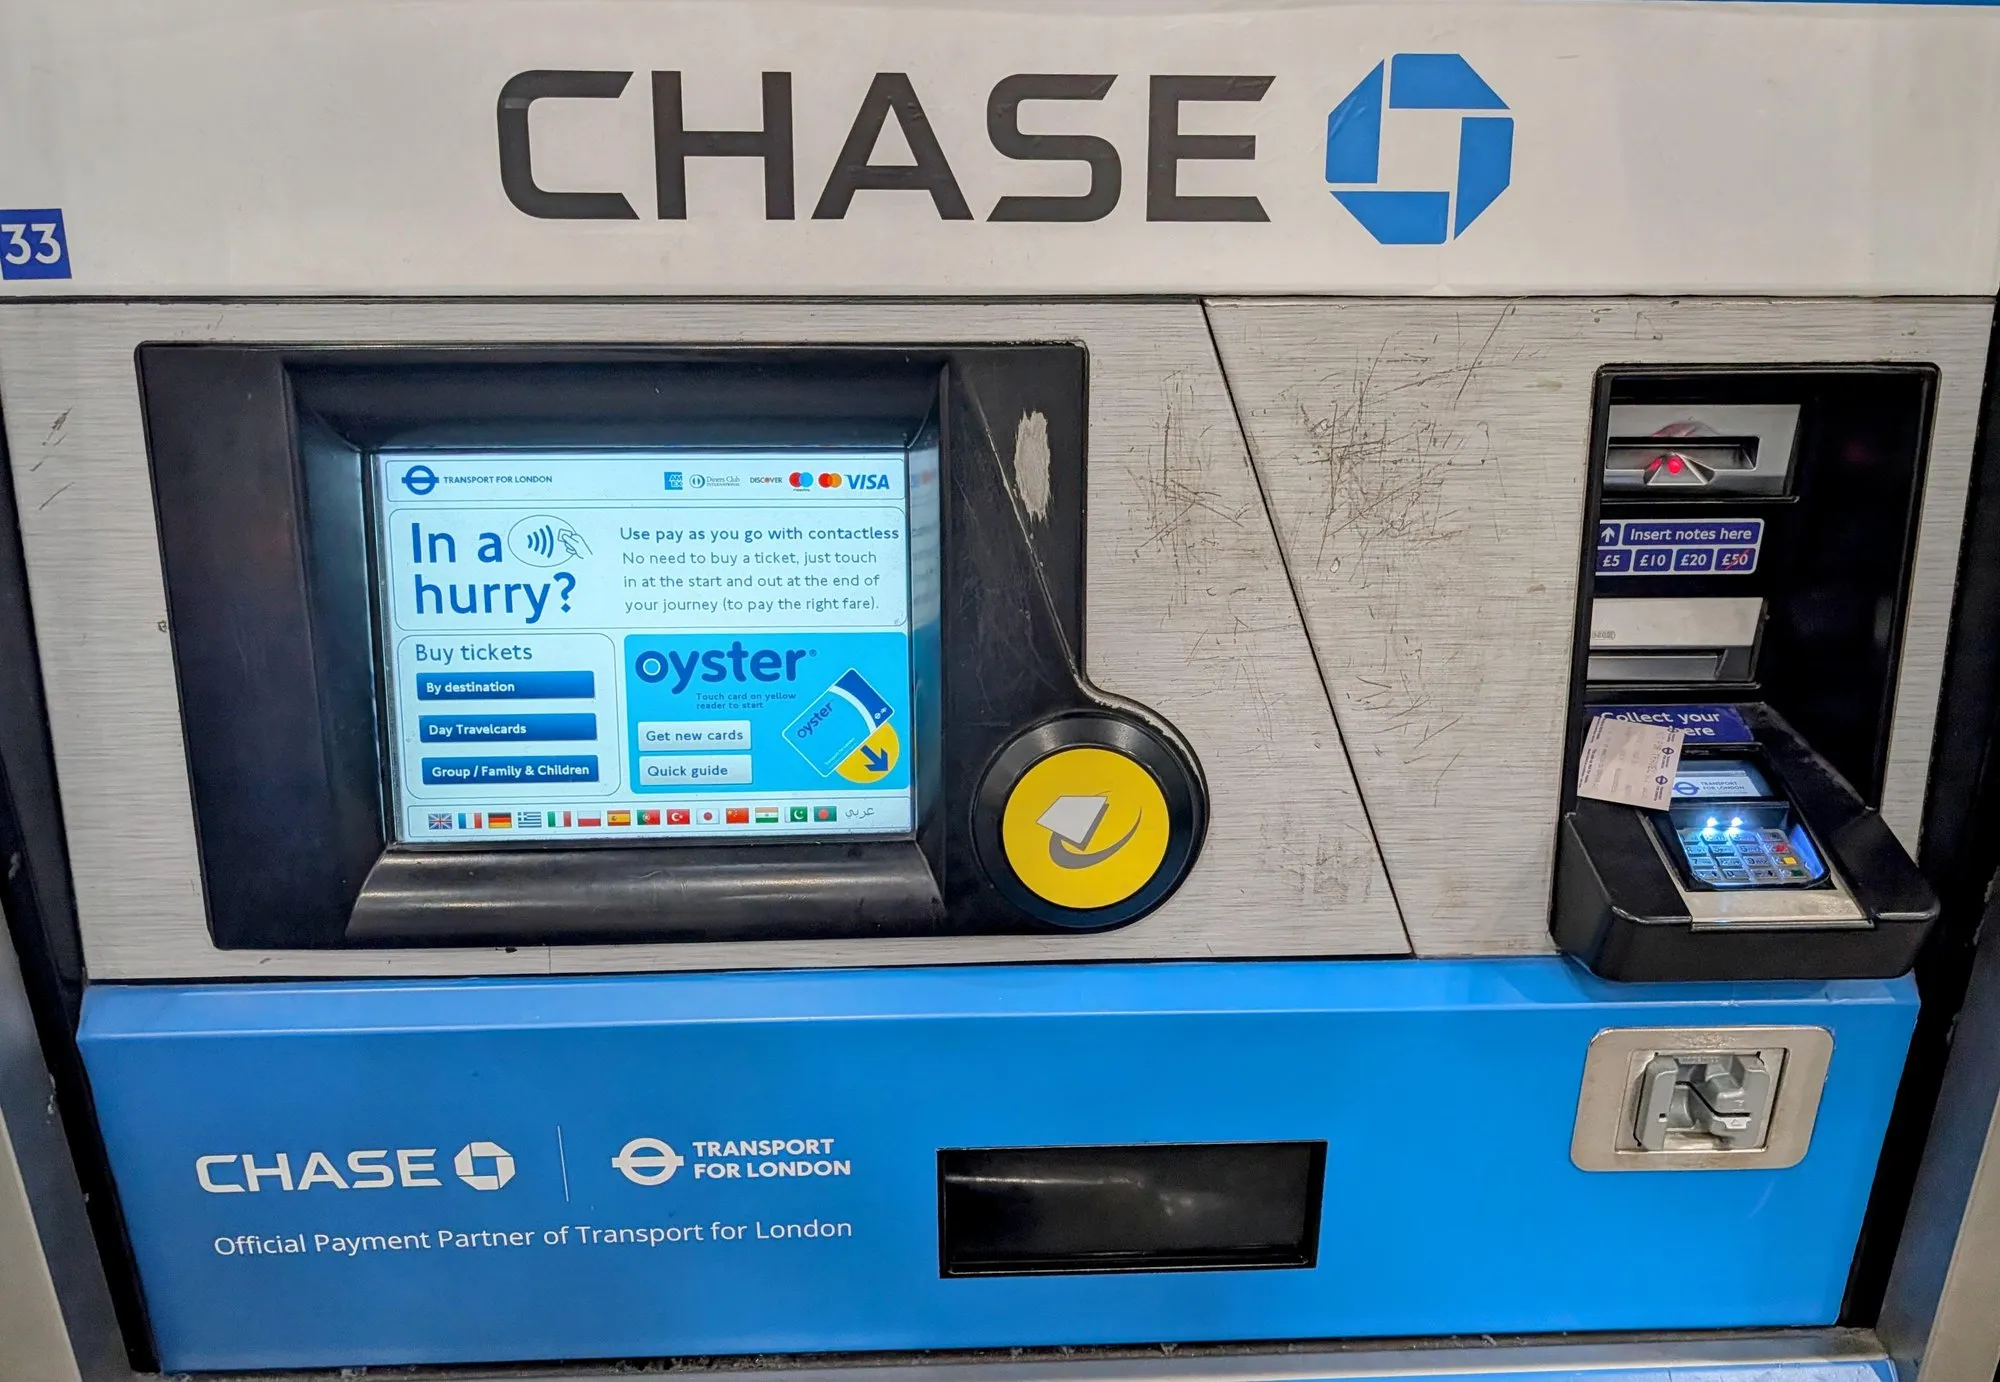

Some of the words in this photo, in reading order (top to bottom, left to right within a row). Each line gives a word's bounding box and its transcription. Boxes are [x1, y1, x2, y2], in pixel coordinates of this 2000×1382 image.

[496, 69, 1276, 222] CHASE
[1, 223, 61, 264] 33
[444, 476, 494, 484] TRANSPORT
[496, 476, 512, 484] FOR
[845, 474, 890, 490] VISA
[620, 527, 650, 540] Use
[656, 530, 683, 544] pay
[689, 530, 705, 540] as
[710, 530, 739, 543] you
[744, 530, 763, 543] go
[768, 526, 802, 540] with
[808, 526, 900, 540] contactless
[1630, 528, 1672, 540] Insert
[1676, 529, 1716, 540] notes
[1720, 528, 1752, 540] here
[412, 523, 456, 563] In
[478, 532, 502, 563] a
[622, 552, 645, 564] No
[650, 552, 686, 564] need
[690, 552, 706, 564] to
[711, 552, 738, 566] buy
[742, 554, 750, 564] a
[754, 552, 800, 566] ticket,
[804, 552, 832, 566] just
[834, 551, 877, 564] touch
[1602, 554, 1620, 567] £5
[1640, 554, 1666, 566] £10
[1680, 554, 1707, 566] £20
[1722, 553, 1748, 566] £50
[624, 576, 637, 588] in
[642, 576, 656, 588] at
[660, 576, 684, 588] the
[688, 576, 722, 588] start
[726, 575, 753, 588] and
[758, 576, 782, 587] out
[786, 576, 801, 587] at
[804, 574, 828, 586] the
[832, 574, 859, 586] end
[864, 574, 880, 586] of
[414, 572, 576, 624] hurry?
[624, 601, 658, 614] your
[662, 598, 718, 614] journey
[722, 597, 743, 611] (to
[748, 600, 774, 614] pay
[778, 598, 802, 610] the
[806, 598, 840, 612] right
[842, 596, 880, 610] fare).
[416, 644, 454, 666] Buy
[460, 643, 533, 661] tickets
[426, 682, 442, 695] By
[444, 681, 515, 693] destination
[696, 692, 725, 700] Touch
[728, 692, 748, 700] card
[764, 692, 797, 702] yellow
[796, 702, 833, 739] oyster
[1677, 712, 1720, 724] your
[428, 725, 452, 738] Day
[456, 724, 527, 735] Travelcards
[646, 730, 671, 742] Get
[676, 732, 702, 742] new
[708, 730, 744, 741] cards
[1676, 726, 1716, 736] ere
[432, 767, 470, 779] Group
[473, 766, 479, 778] /
[482, 765, 522, 779] Family
[524, 766, 535, 776] &
[538, 764, 590, 776] Children
[648, 766, 686, 777] Quick
[691, 764, 728, 778] guide
[845, 806, 875, 820] عربي
[692, 1138, 834, 1157] TRANSPORT
[196, 1148, 443, 1193] CHASE
[694, 1163, 741, 1179] FOR
[746, 1160, 850, 1178] LONDON
[214, 1234, 306, 1256] Official
[314, 1231, 431, 1256] Payment
[438, 1228, 536, 1248] Partner
[544, 1226, 570, 1245] of
[575, 1222, 704, 1248] Transport
[710, 1220, 748, 1240] for
[756, 1218, 852, 1238] London
